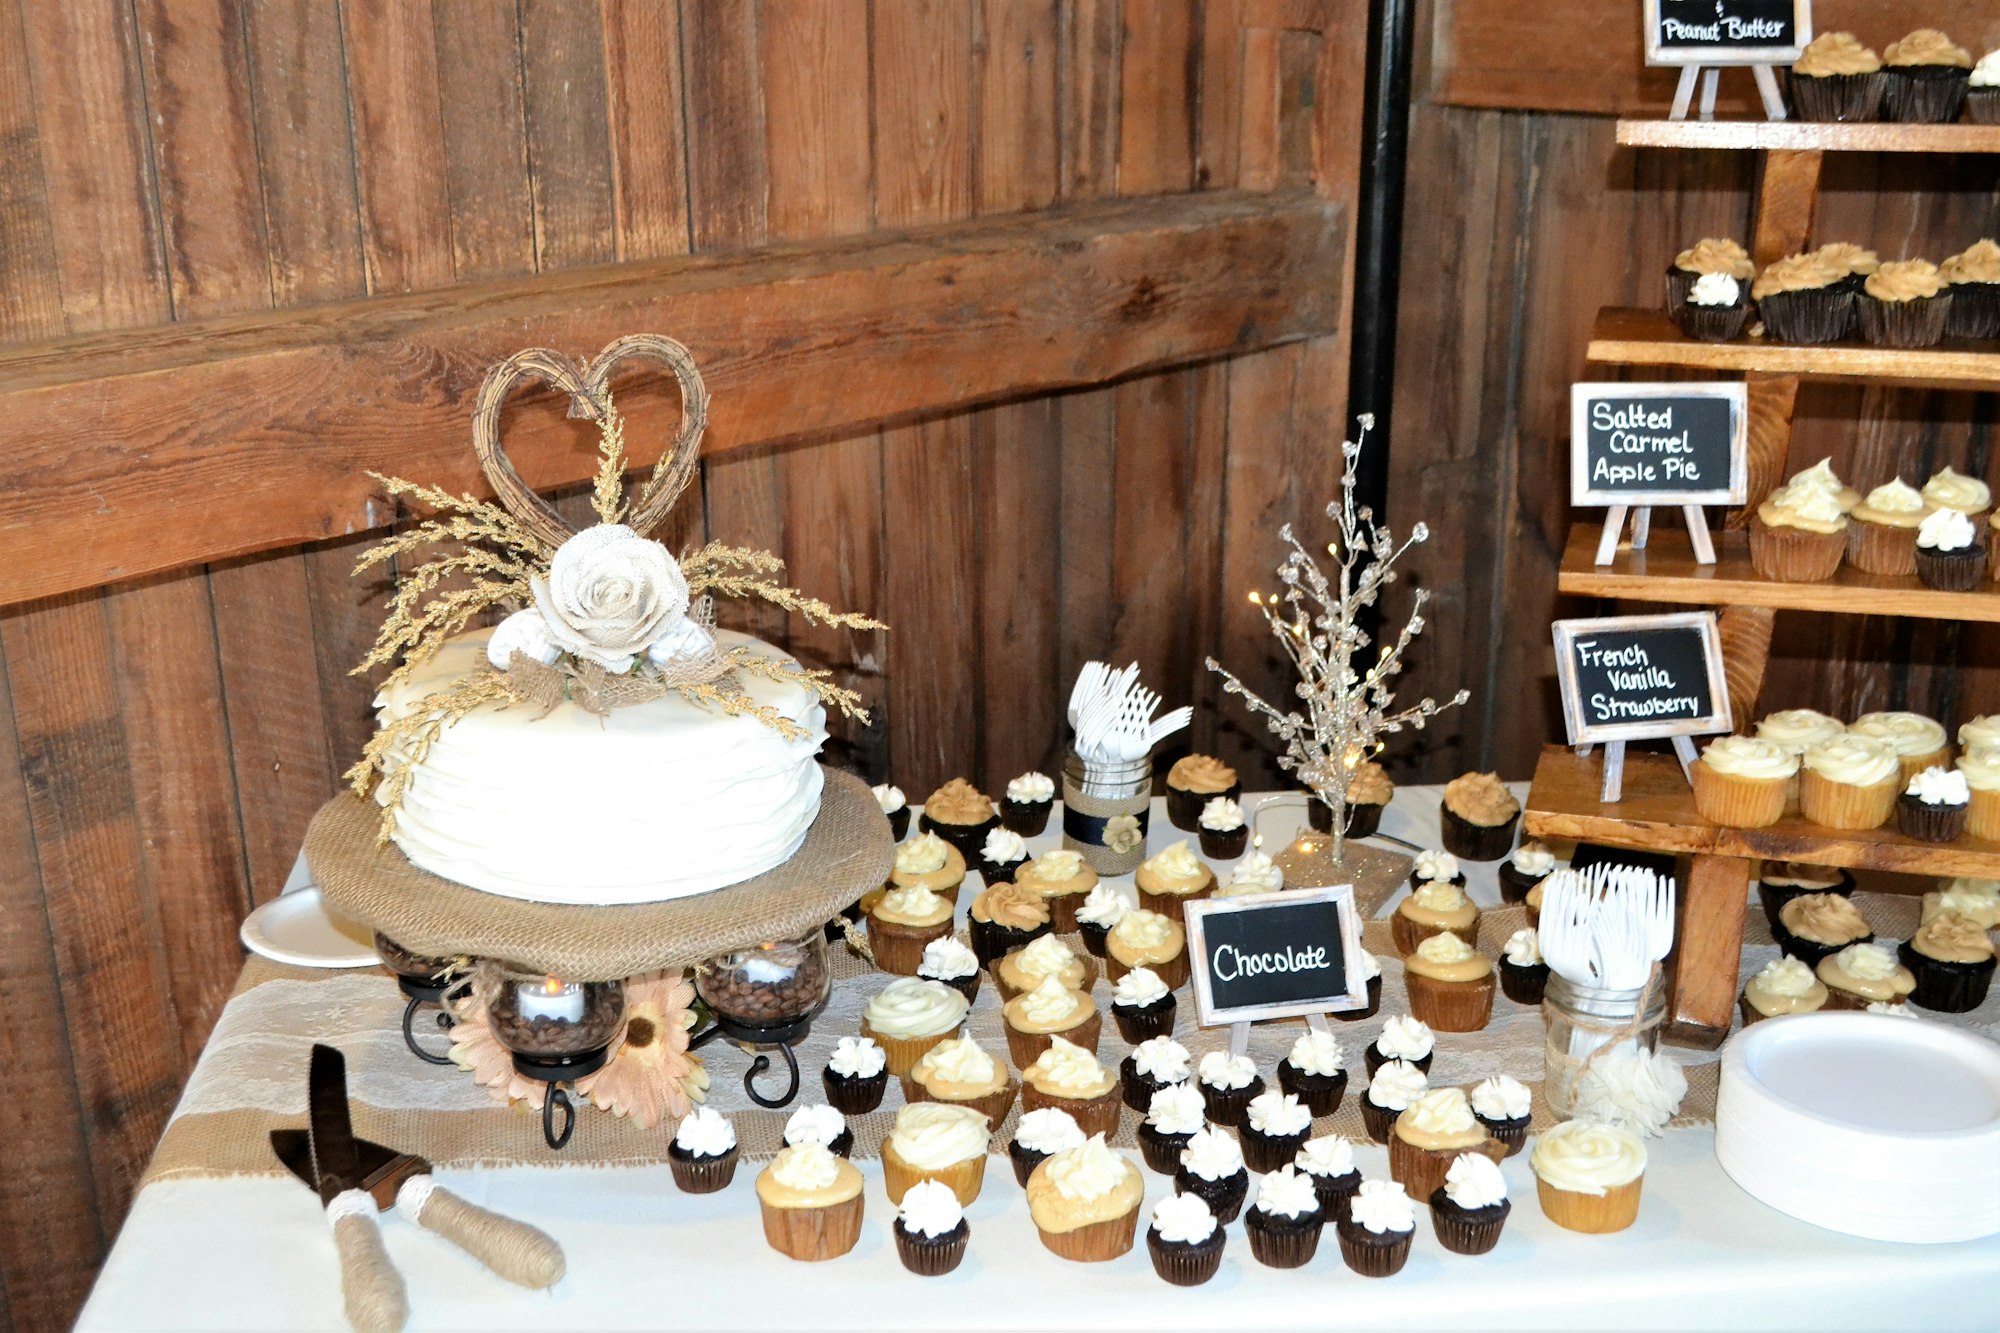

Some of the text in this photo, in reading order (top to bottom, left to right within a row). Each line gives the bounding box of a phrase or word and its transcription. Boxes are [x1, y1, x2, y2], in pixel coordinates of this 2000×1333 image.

[1661, 16, 1786, 42] Peanut Butter
[1592, 402, 1673, 431] Salted
[1610, 430, 1695, 454] Carmel
[1593, 456, 1701, 484] Apple Pie
[1575, 641, 1649, 667] French
[1607, 665, 1676, 691] Vanilla
[1591, 693, 1698, 720] Strawberry
[1213, 944, 1331, 982] Chocolate
